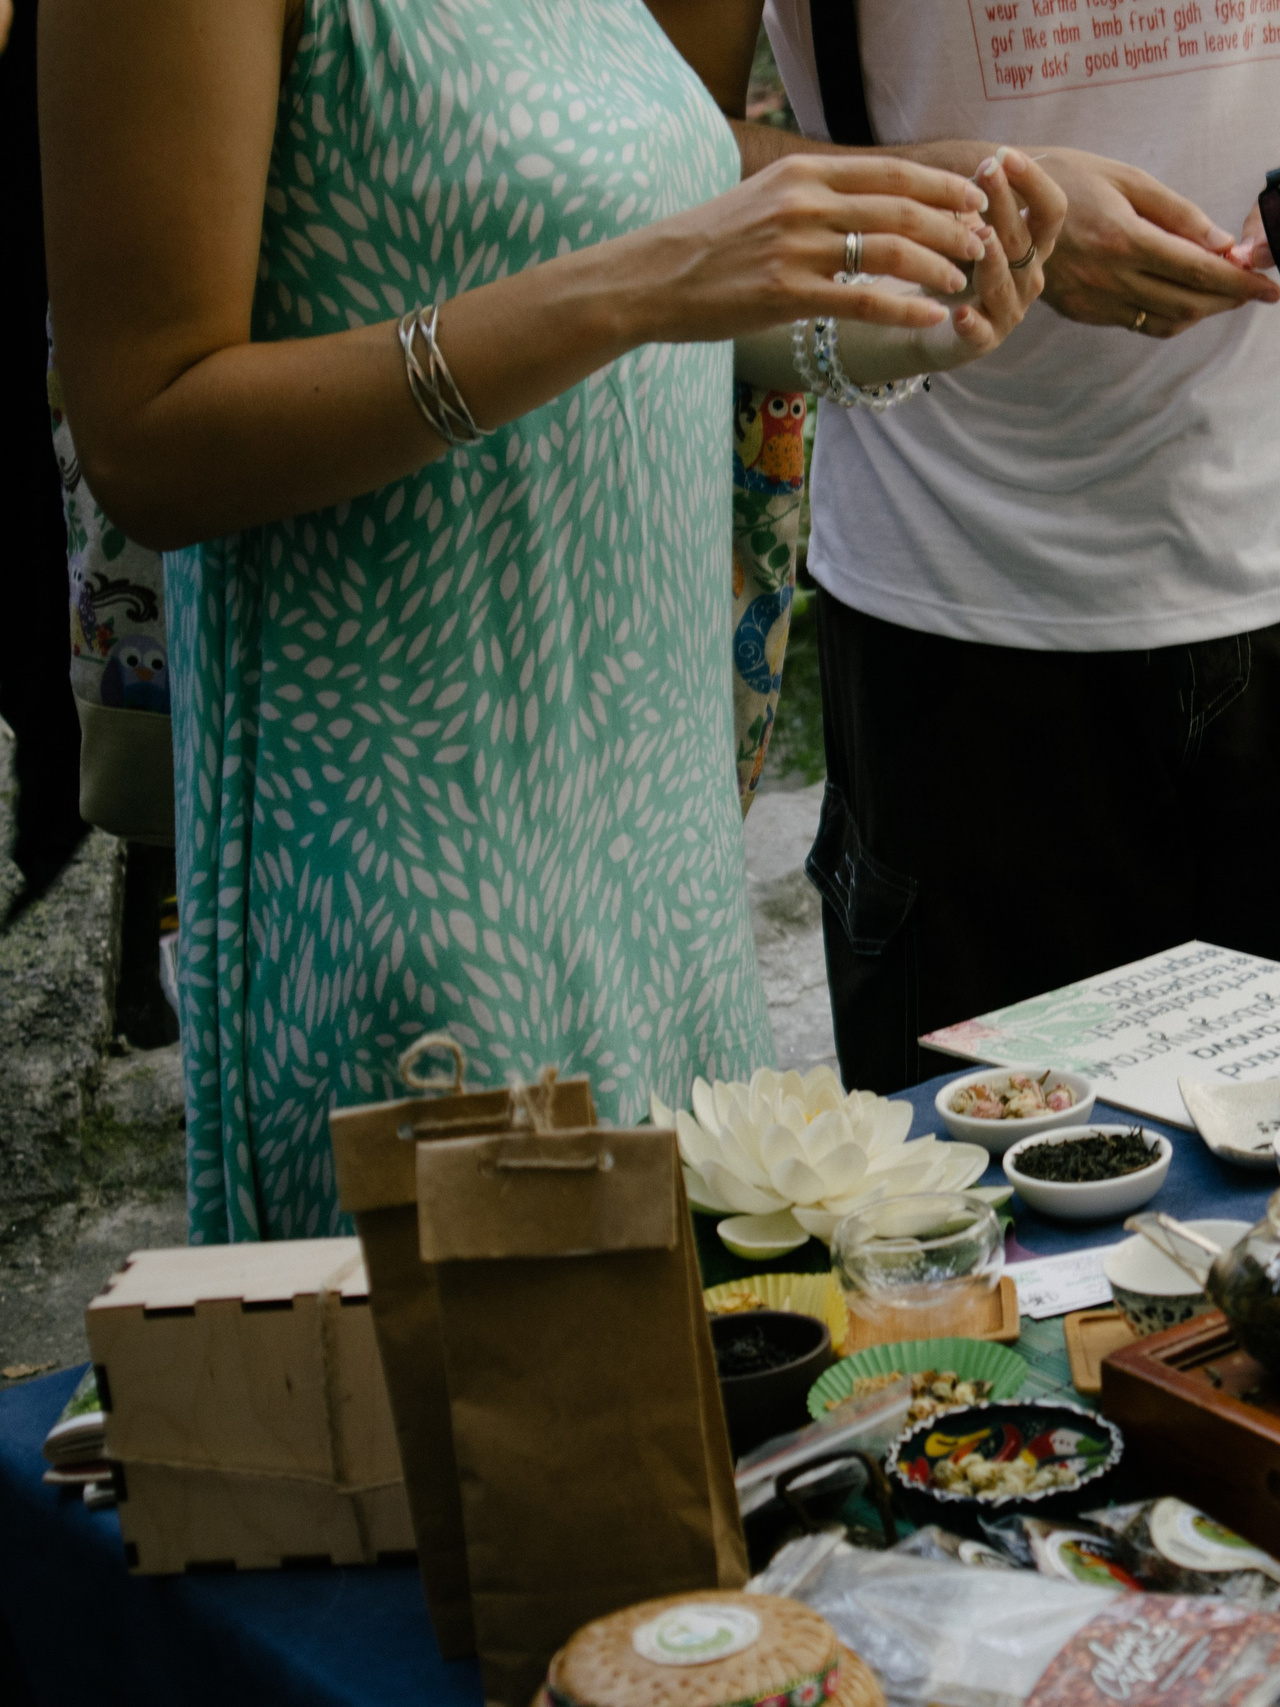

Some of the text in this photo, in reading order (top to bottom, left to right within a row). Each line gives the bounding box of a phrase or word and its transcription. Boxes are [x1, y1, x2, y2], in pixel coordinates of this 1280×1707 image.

[991, 28, 1015, 59] guf
[1022, 26, 1048, 50] like
[1092, 15, 1123, 39] bmb
[1129, 6, 1167, 33] fruit
[1032, 0, 1077, 18] karma
[994, 62, 1033, 90] happy
[1041, 53, 1070, 79] dskf
[1084, 46, 1119, 77] good
[1178, 35, 1199, 58] bm
[1203, 29, 1238, 54] leave
